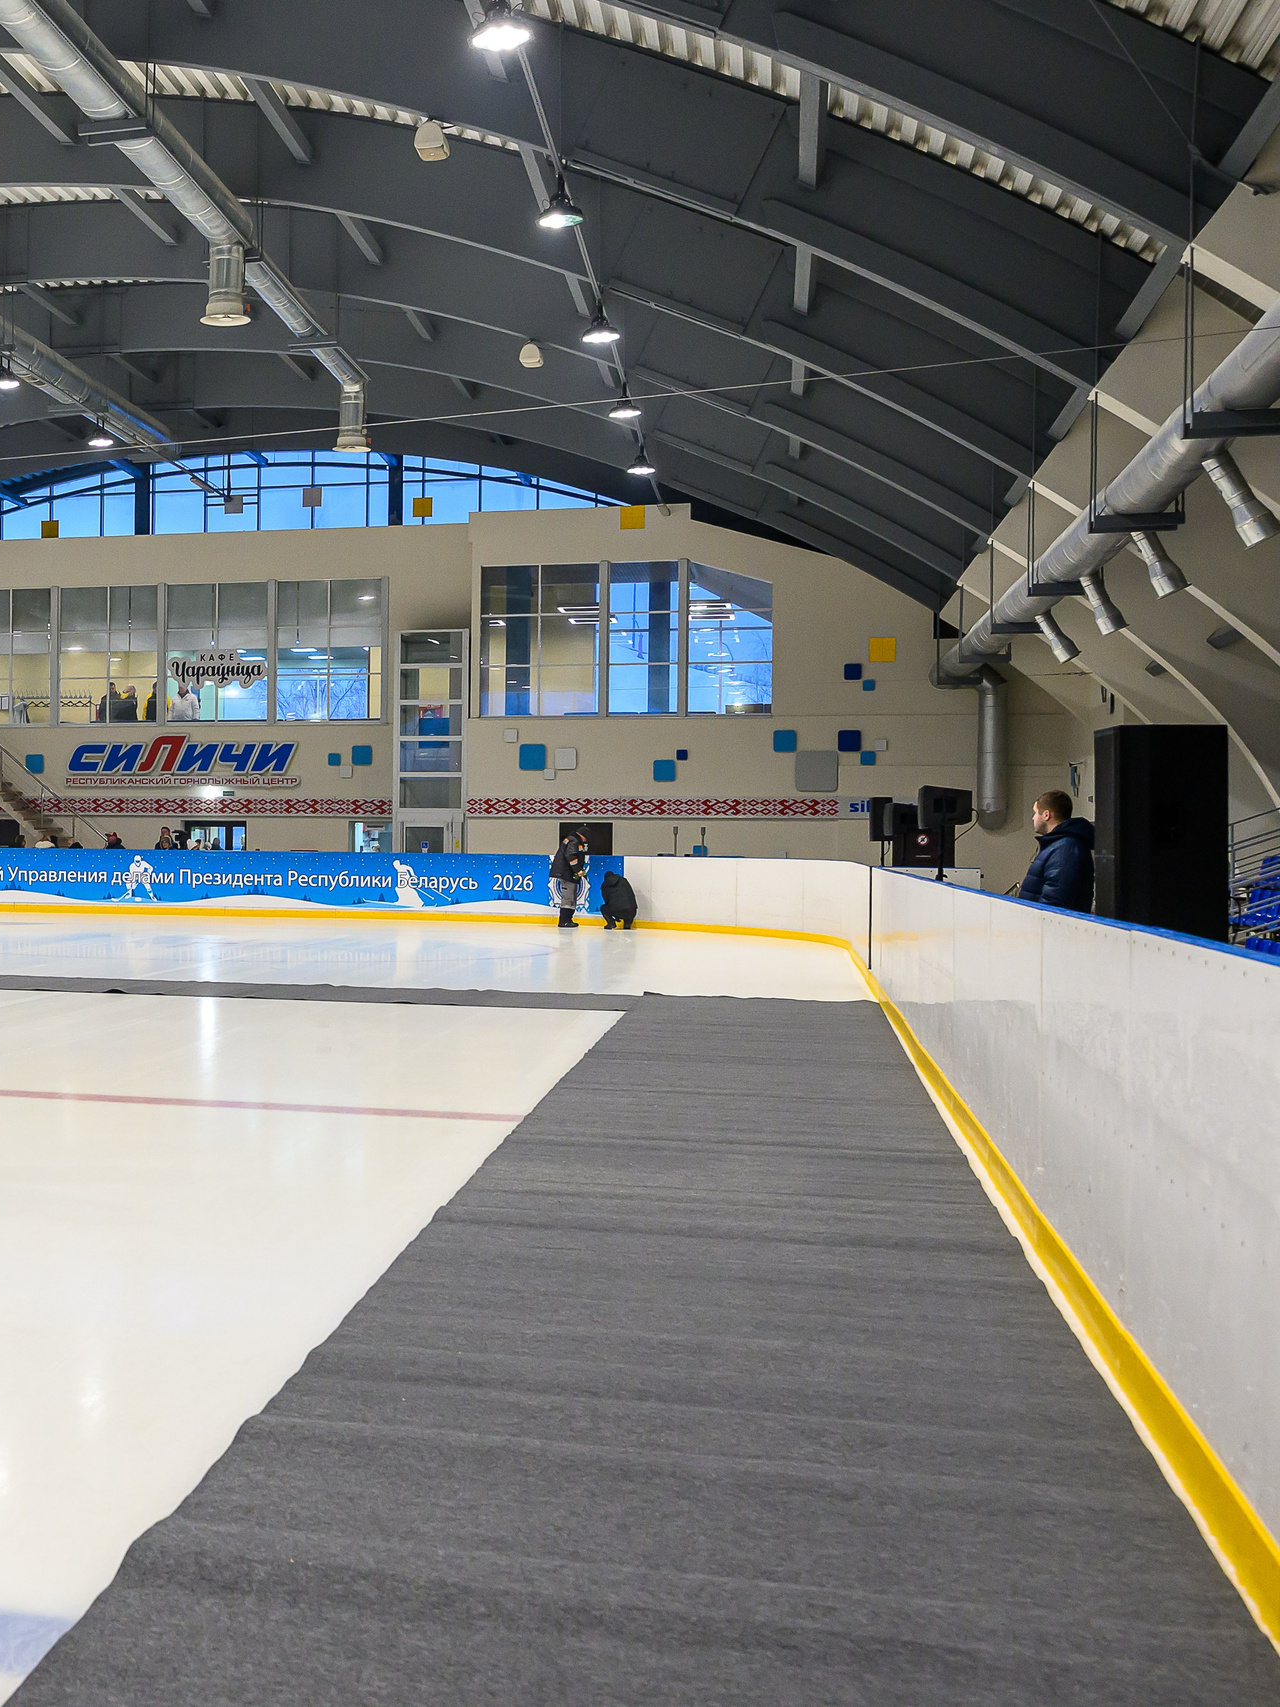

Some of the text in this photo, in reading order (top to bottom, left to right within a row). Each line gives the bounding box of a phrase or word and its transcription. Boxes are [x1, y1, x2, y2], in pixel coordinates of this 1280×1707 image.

[200, 653, 234, 662] КАФЕ
[66, 775, 298, 787] РЕСПУБЛИКАНСКИЙ ГОРНОЛЫЖНЫЙ ЦЕНТР
[7, 866, 108, 885] Управления
[111, 869, 174, 886] делами
[179, 868, 283, 889] Президента
[287, 870, 392, 891] Республики
[397, 872, 479, 893] Беларусь
[492, 873, 534, 892] 2026
